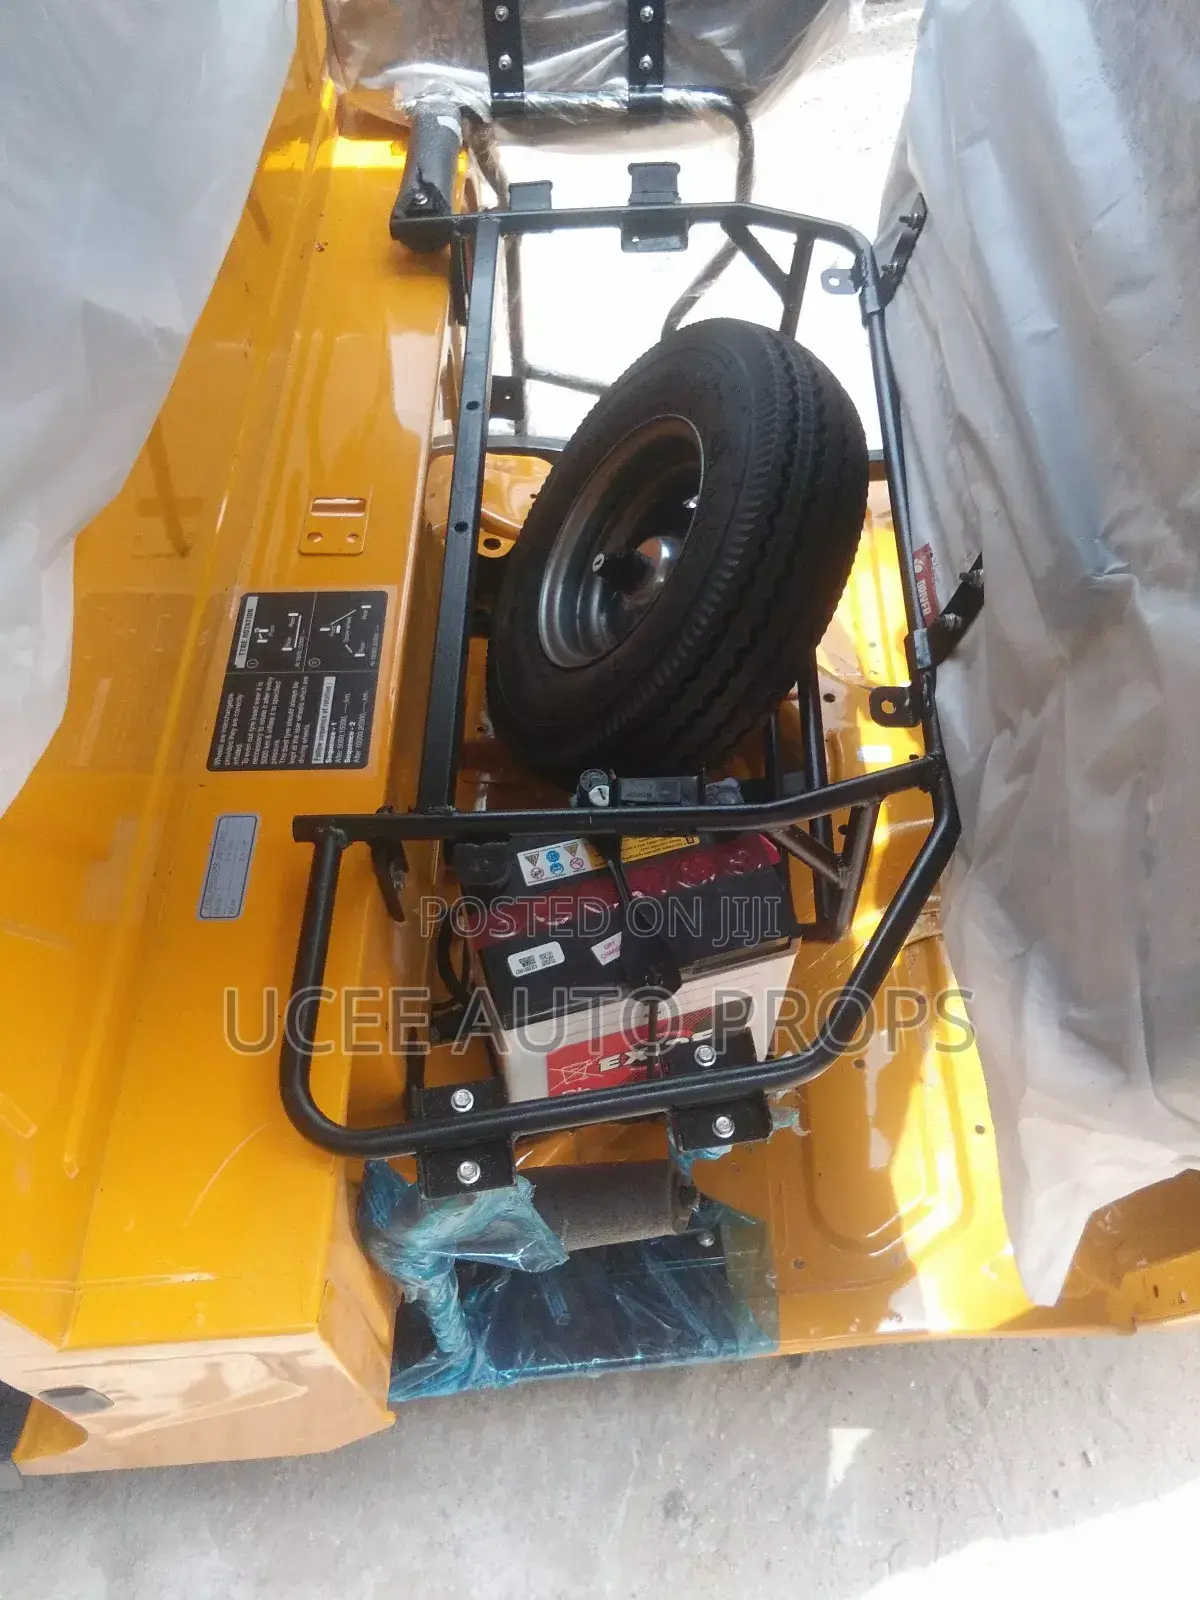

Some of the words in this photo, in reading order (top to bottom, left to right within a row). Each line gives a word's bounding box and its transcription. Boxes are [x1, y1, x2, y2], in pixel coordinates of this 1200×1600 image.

[242, 608, 254, 638] ROTATION
[239, 639, 248, 656] TYRE
[325, 731, 336, 763] Sequence
[345, 731, 354, 763] Sequence
